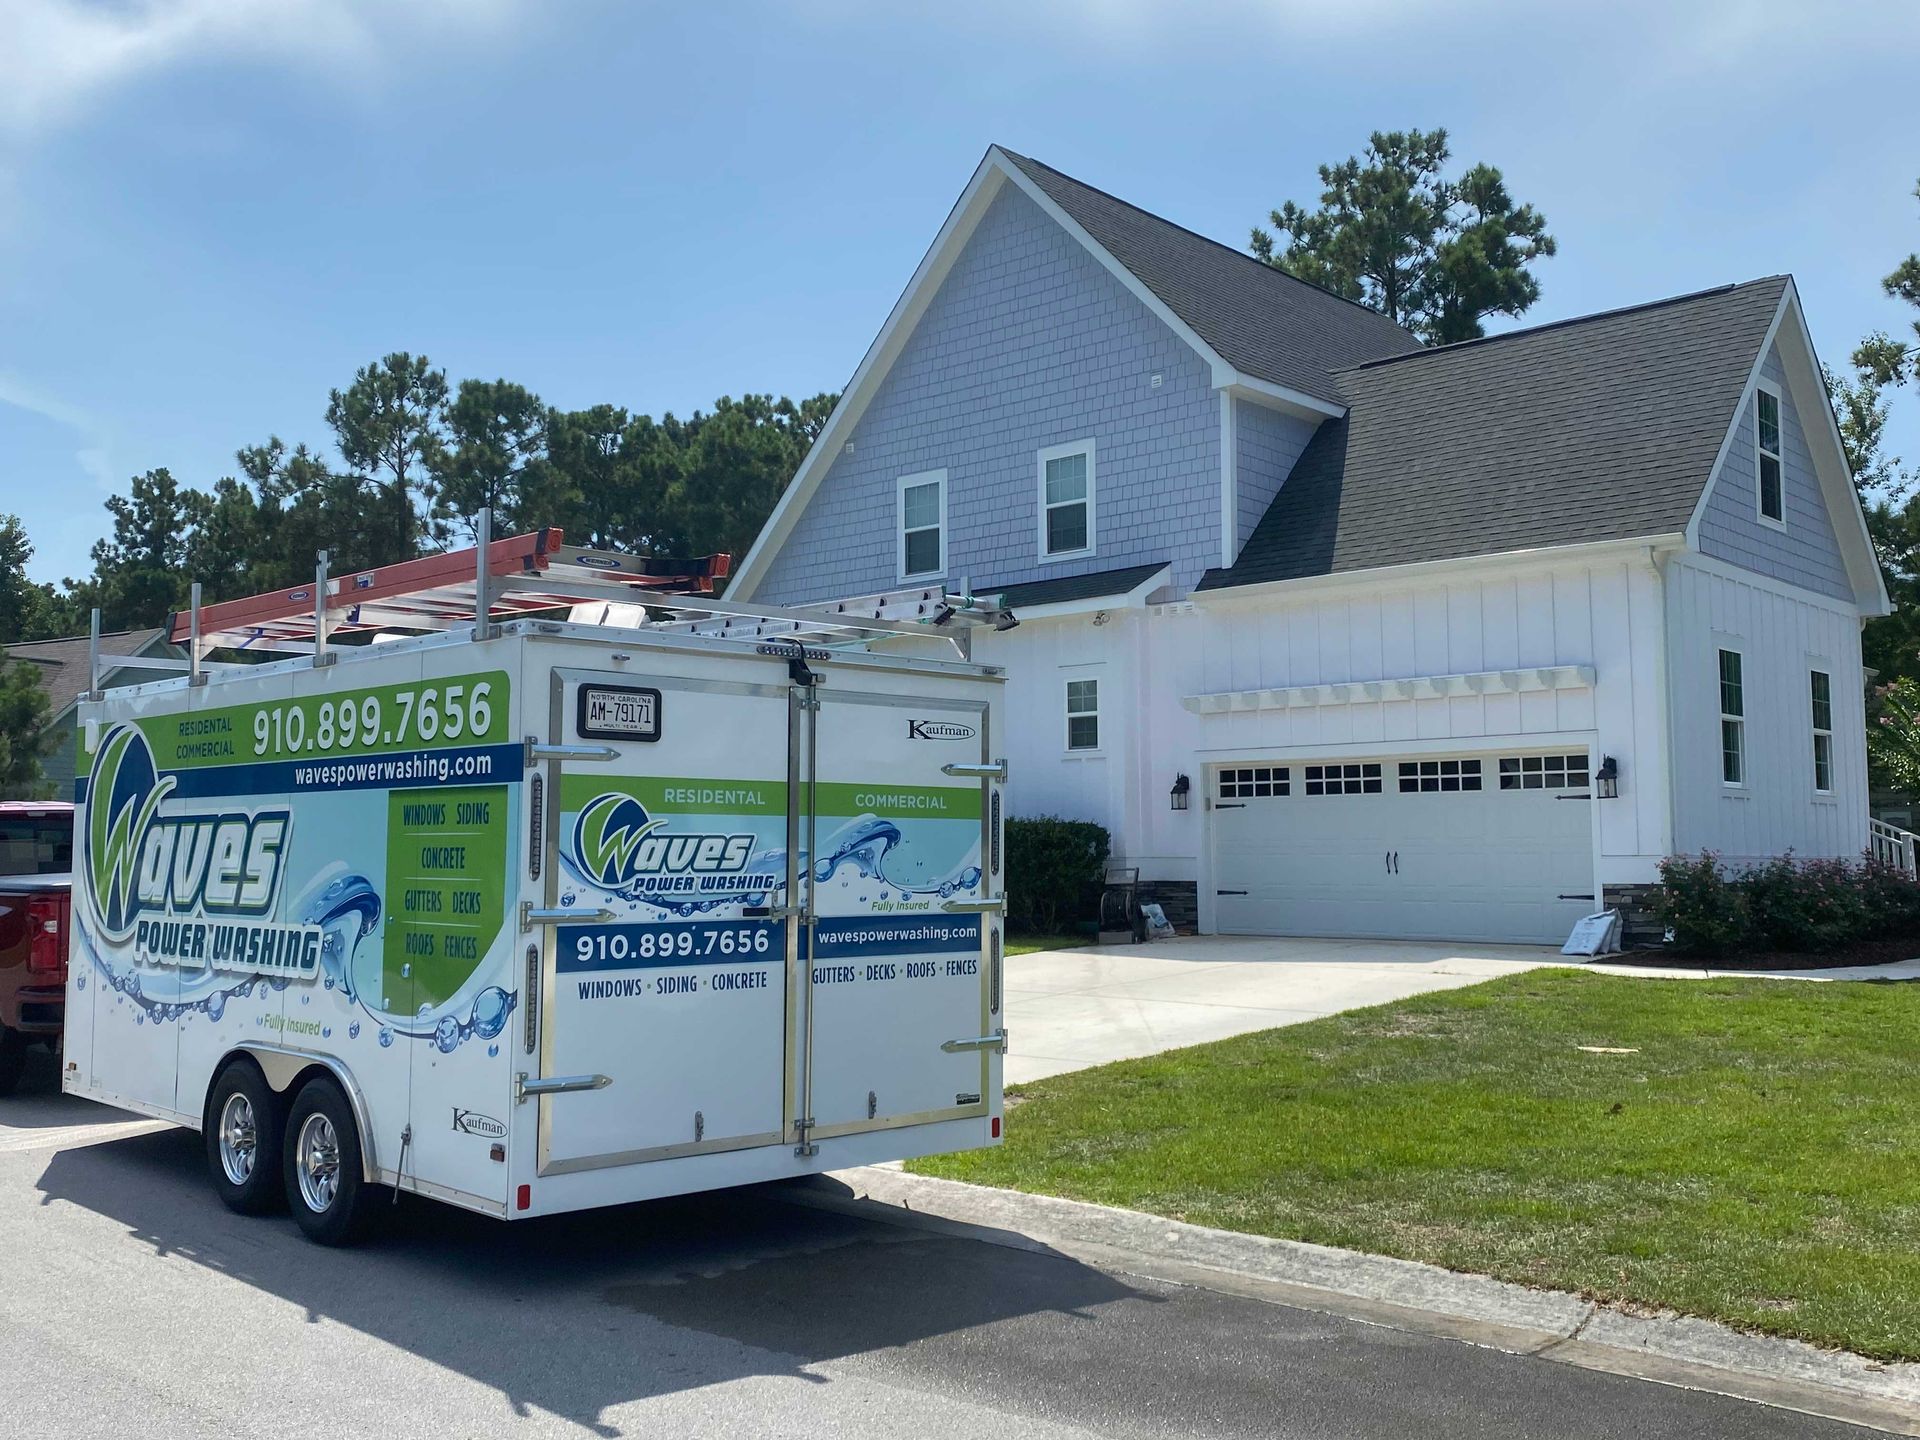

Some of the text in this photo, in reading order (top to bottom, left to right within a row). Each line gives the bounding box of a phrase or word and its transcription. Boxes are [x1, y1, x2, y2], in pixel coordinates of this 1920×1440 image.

[617, 695, 652, 704] CAROLINA
[253, 681, 492, 755] 910.899.7656
[590, 701, 651, 723] AM-79171
[179, 717, 233, 737] RESIDENTAL
[906, 719, 970, 740] Kaufman
[176, 740, 235, 760] COMMERCIAL
[295, 754, 492, 787] wavespowerwashing.com
[664, 788, 766, 805] RESIDENTAL
[855, 794, 947, 809] COMMERCIAL
[403, 802, 490, 825] WINDOWS SIDING
[421, 847, 466, 869] CONCRETE
[632, 875, 775, 892] POWER WASHING
[404, 889, 481, 914] GUTTERS DECKS
[871, 900, 930, 913] Fully Insured
[136, 920, 318, 970] POWER WASHING
[406, 932, 477, 960] ROOFS FENCES
[576, 929, 769, 962] 910.899.7656
[818, 926, 977, 944] wavespowerwashing.com
[812, 959, 977, 985] GUTTERS DECKS ROOFS FENCES
[578, 971, 767, 1000] WINDOWS SIDING CONCRETE
[264, 1013, 321, 1036] Fully Insured
[451, 1106, 503, 1135] Kaufman
